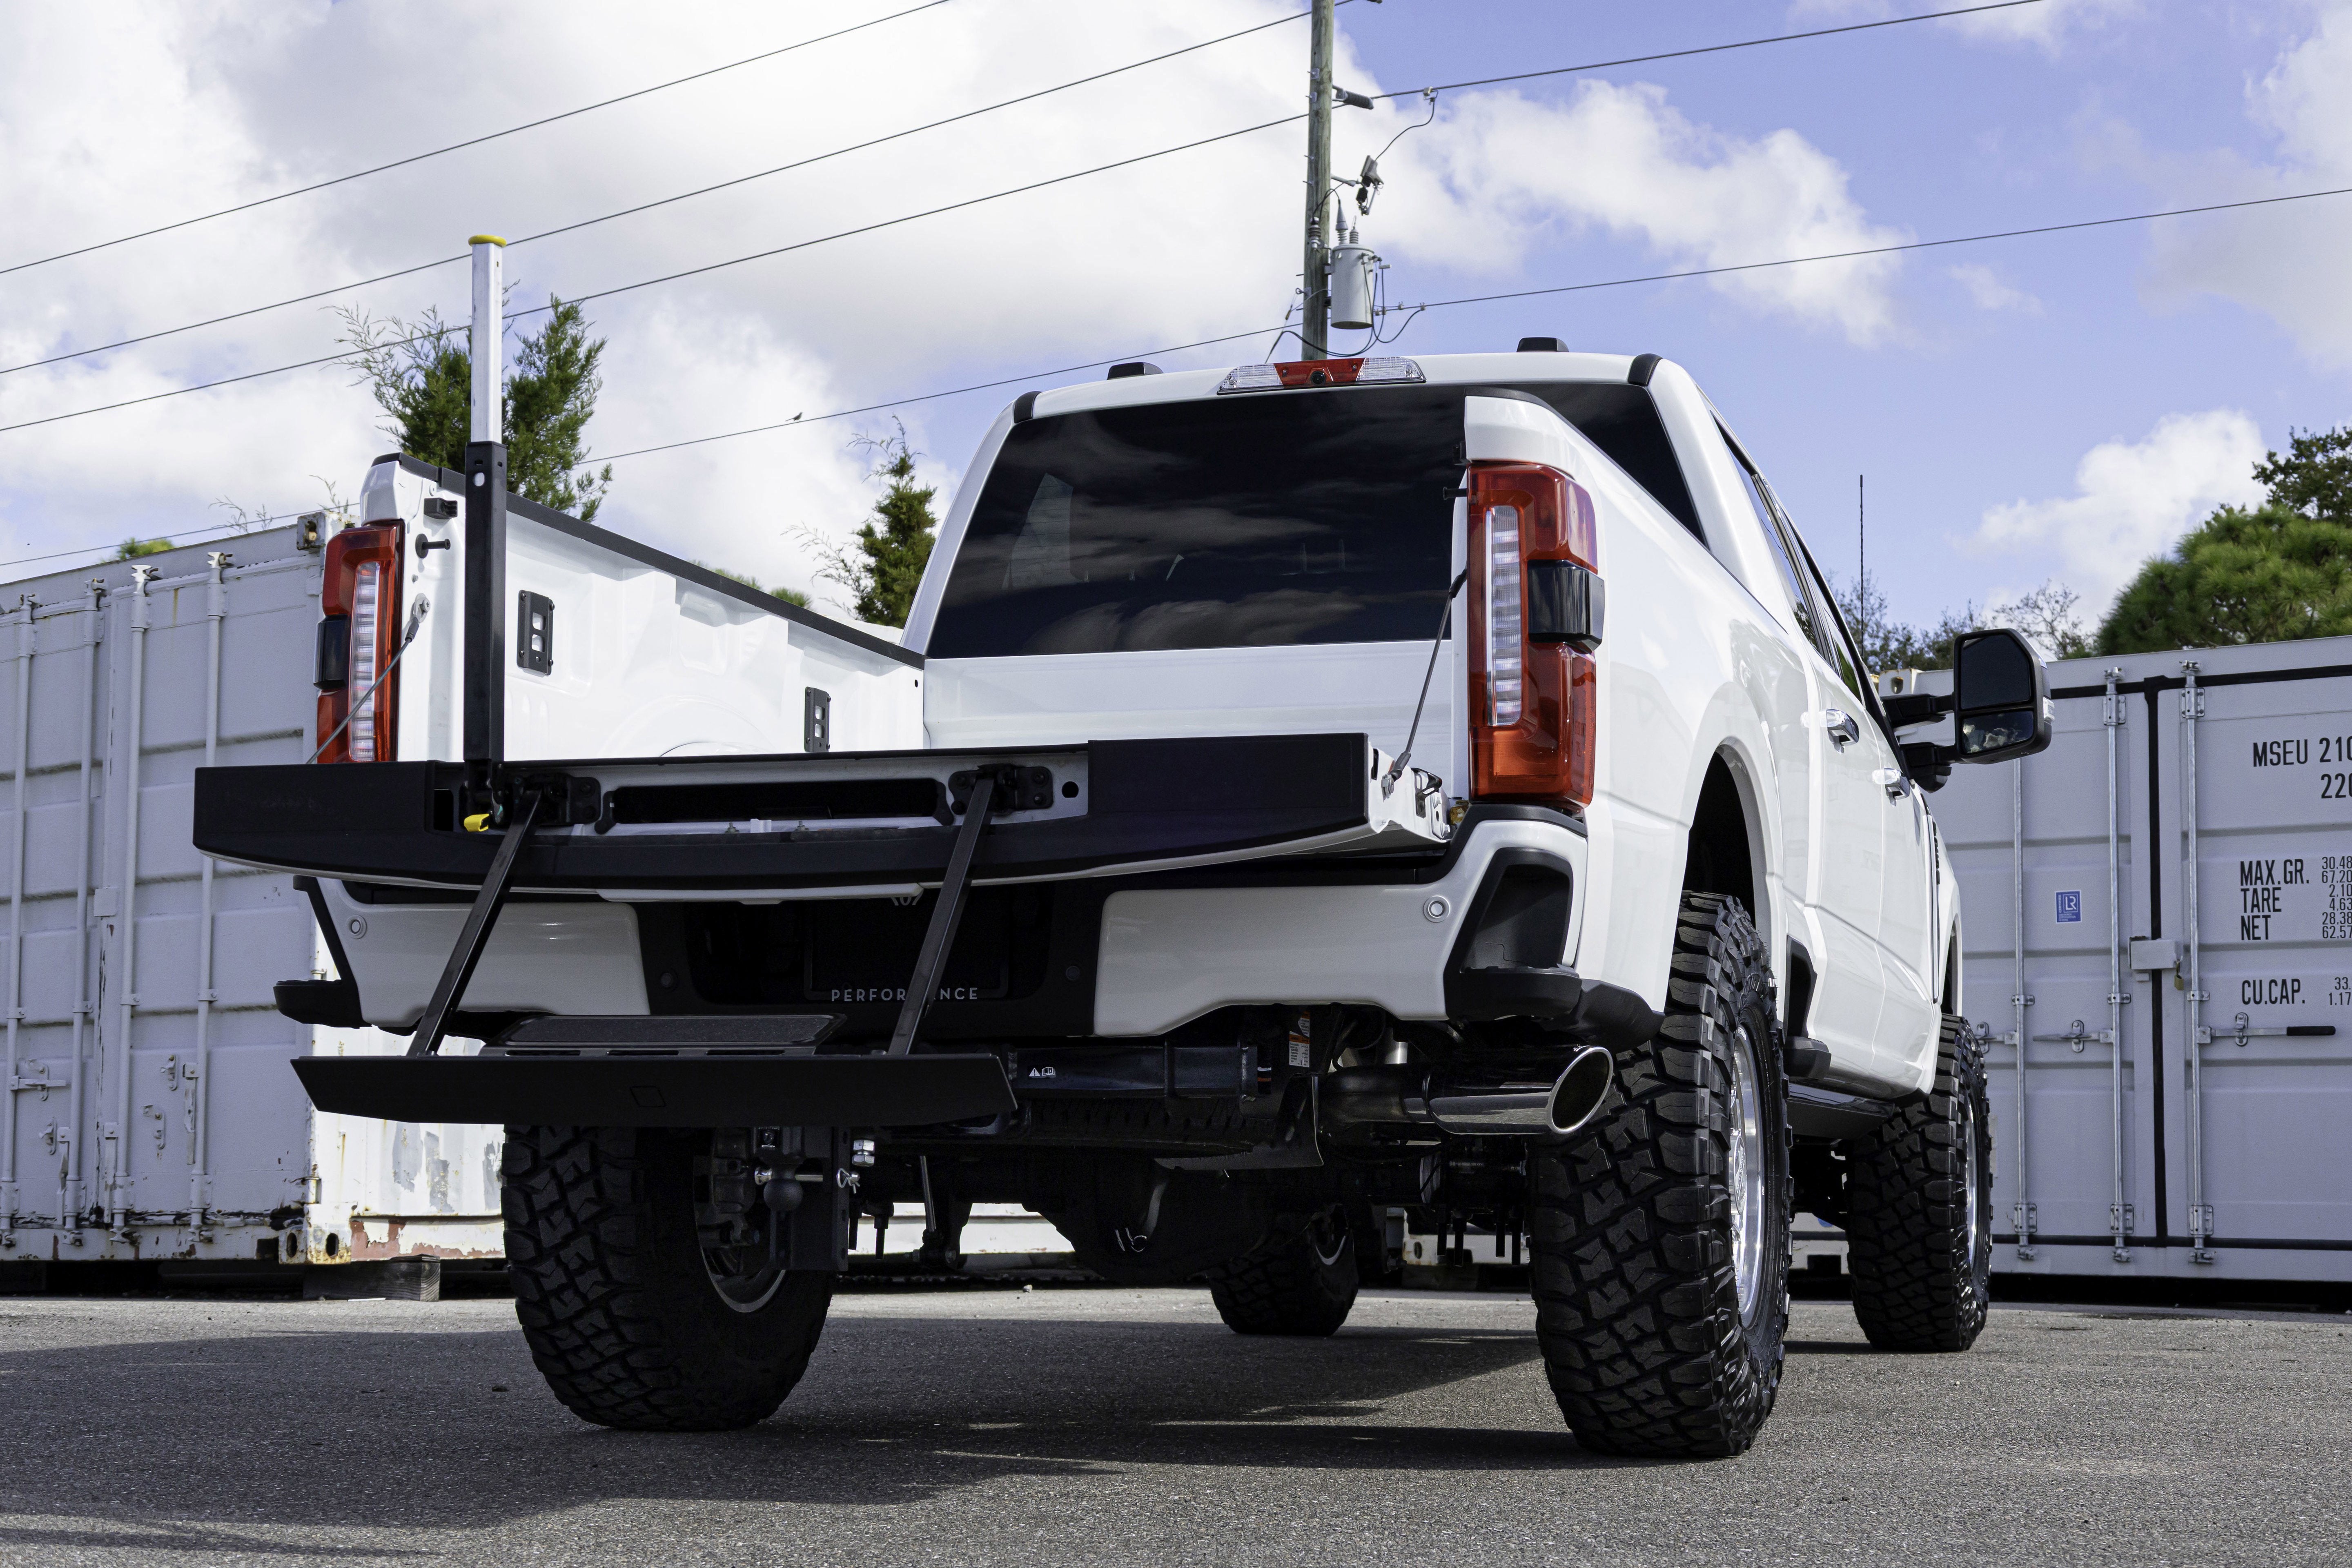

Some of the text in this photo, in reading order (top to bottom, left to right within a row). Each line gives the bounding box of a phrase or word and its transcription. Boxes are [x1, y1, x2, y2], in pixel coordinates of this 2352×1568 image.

[2253, 739, 2308, 767] MSEU
[2240, 859, 2309, 886] MAX.GR.
[2241, 887, 2282, 913] TARE
[2241, 914, 2271, 941] NET
[832, 987, 978, 1002] PERFORNCE
[2242, 978, 2305, 1005] CU.CAP.
